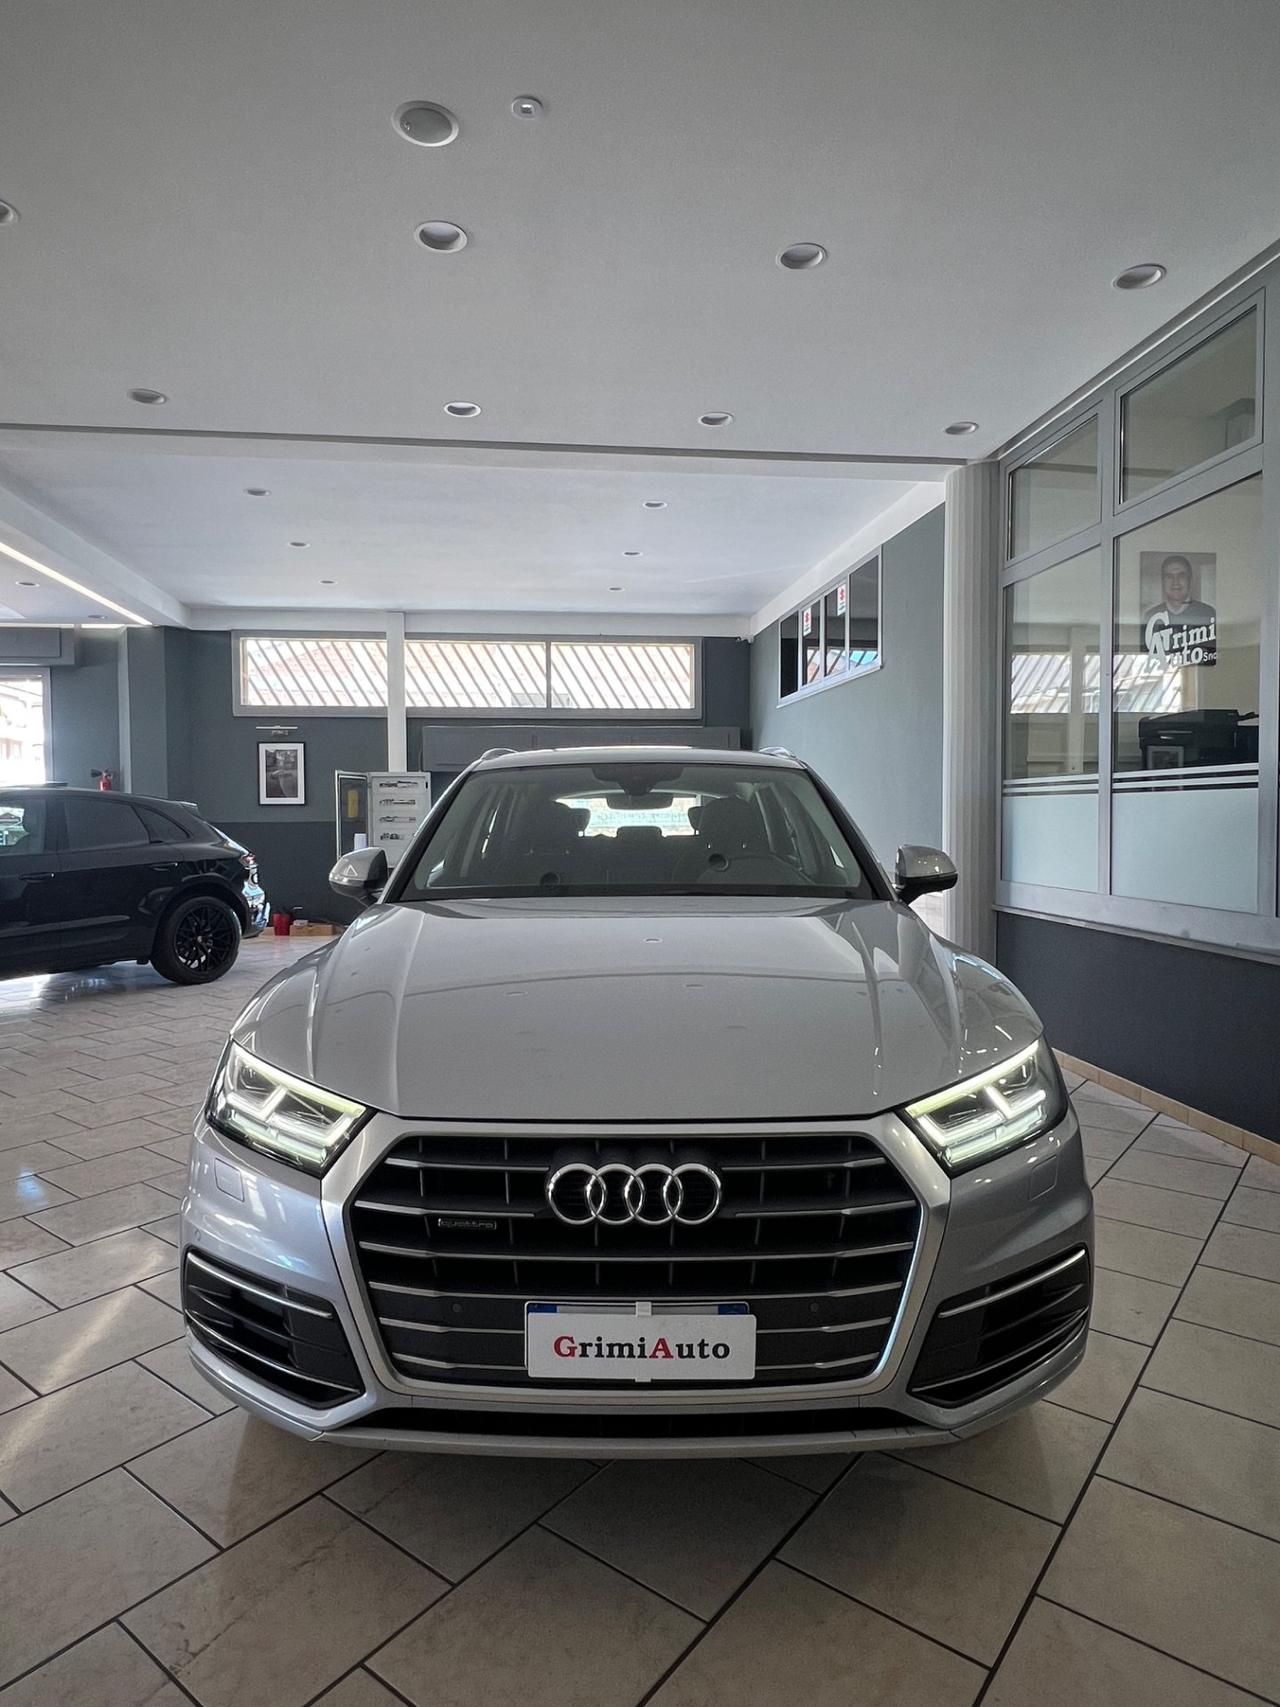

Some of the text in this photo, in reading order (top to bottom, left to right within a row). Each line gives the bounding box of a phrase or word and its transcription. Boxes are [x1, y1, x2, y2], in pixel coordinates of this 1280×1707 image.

[1145, 611, 1216, 654] Grimi
[1148, 633, 1203, 672] Auto
[553, 1335, 731, 1359] GrimiAuto
